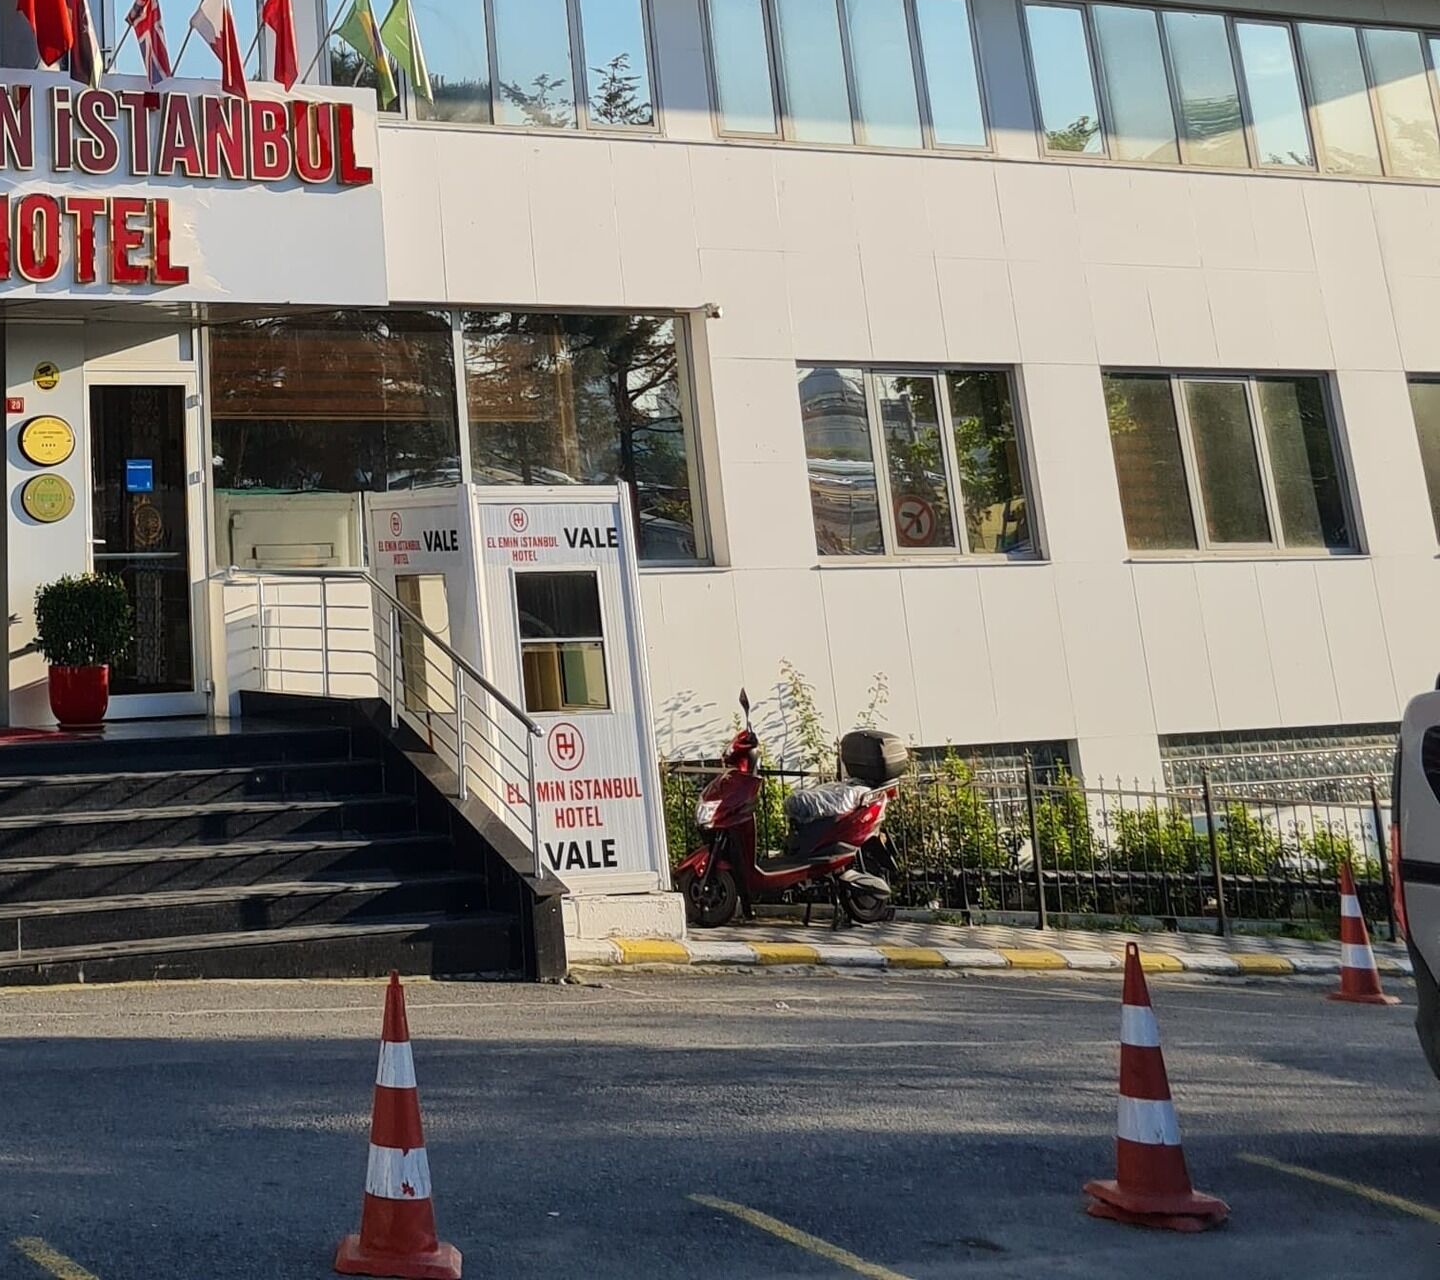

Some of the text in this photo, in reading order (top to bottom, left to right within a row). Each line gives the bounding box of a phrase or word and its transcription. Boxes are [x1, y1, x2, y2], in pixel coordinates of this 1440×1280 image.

[423, 529, 459, 552] VALE
[486, 536, 497, 549] EL
[563, 526, 620, 549] VALE
[512, 549, 539, 562] HOTEL
[506, 783, 526, 805] EL
[554, 805, 604, 829] HOTEL
[544, 838, 618, 871] VALE
